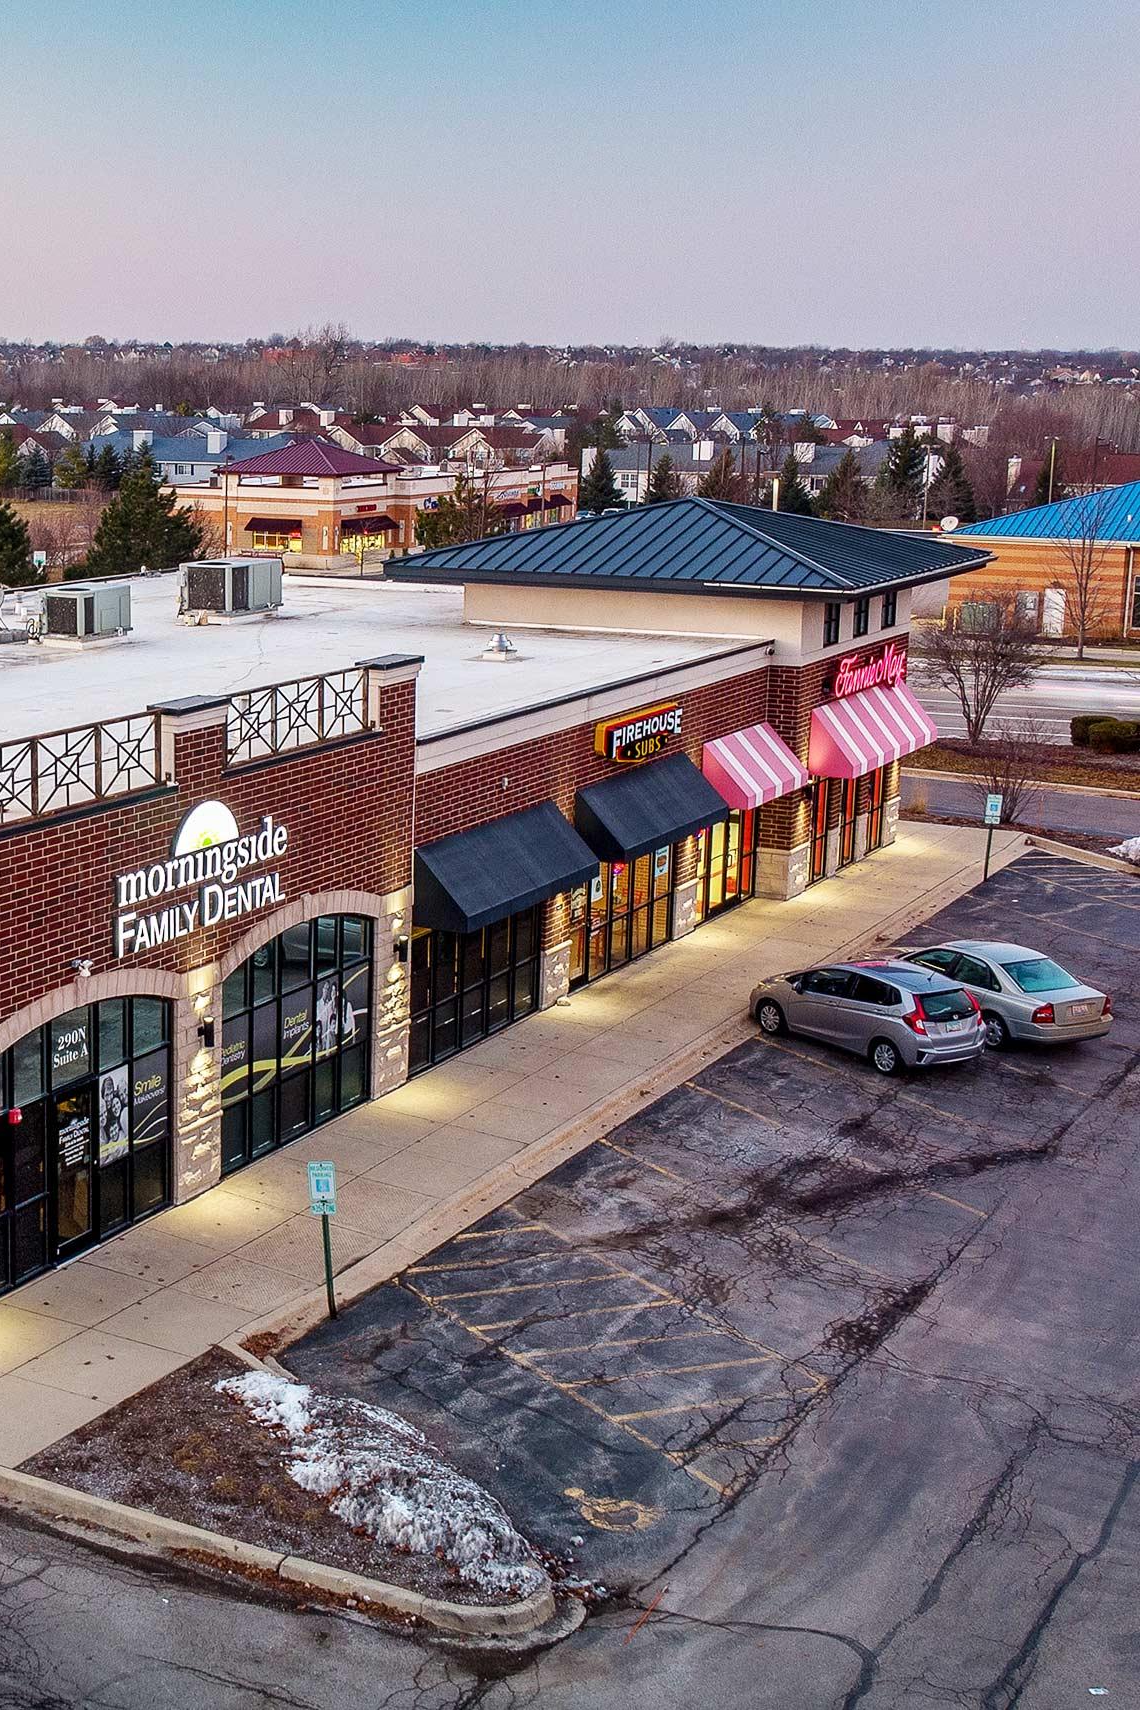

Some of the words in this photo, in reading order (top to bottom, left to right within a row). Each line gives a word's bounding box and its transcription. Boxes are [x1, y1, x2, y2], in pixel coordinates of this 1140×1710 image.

[835, 654, 876, 697] Fannie
[876, 644, 906, 687] May
[612, 708, 683, 759] FIREHOUSE
[635, 735, 661, 758] SUBS
[117, 815, 288, 907] morningside
[117, 901, 200, 958] FAMILY
[204, 872, 286, 927] DENTAL
[284, 1008, 308, 1029] Dental
[57, 1026, 86, 1051] 290N
[53, 1050, 79, 1068] Suite
[80, 1042, 89, 1058] A
[133, 1075, 162, 1096] Smile
